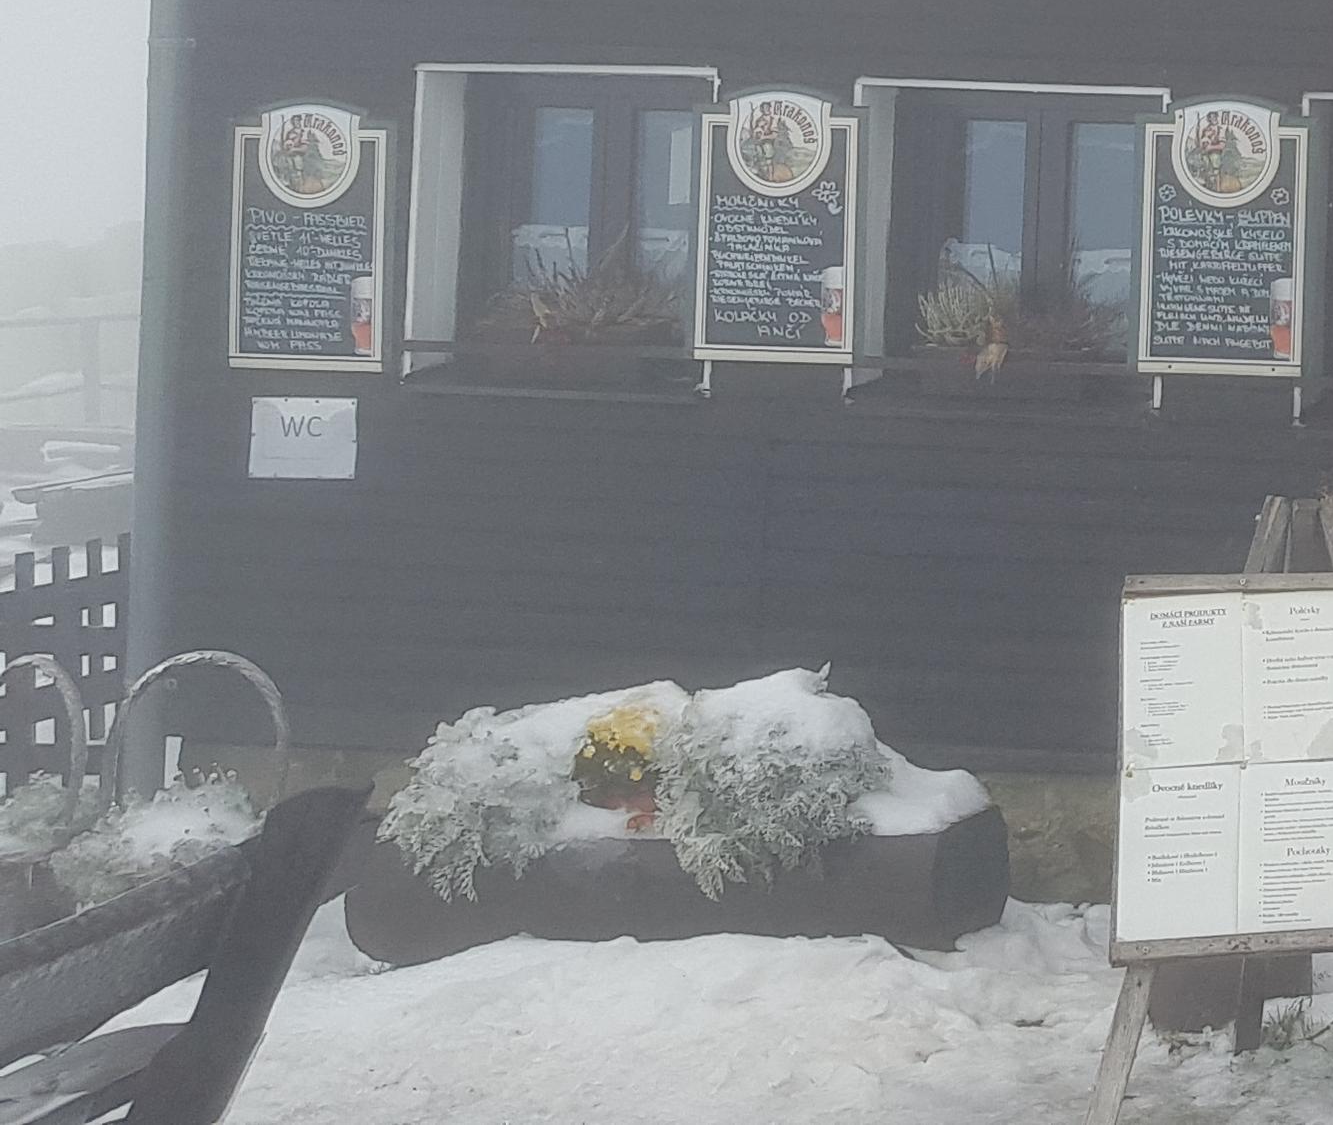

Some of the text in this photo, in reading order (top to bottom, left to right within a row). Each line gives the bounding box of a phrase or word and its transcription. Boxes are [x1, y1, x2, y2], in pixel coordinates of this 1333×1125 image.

[247, 208, 286, 223] PIVO
[1240, 229, 1285, 240] KYSELO
[1167, 239, 1175, 248] S
[1169, 261, 1189, 269] MIT
[789, 312, 812, 323] OD
[1154, 321, 1180, 332] DLE
[281, 416, 322, 437] WC
[1152, 782, 1185, 792] Ovocné
